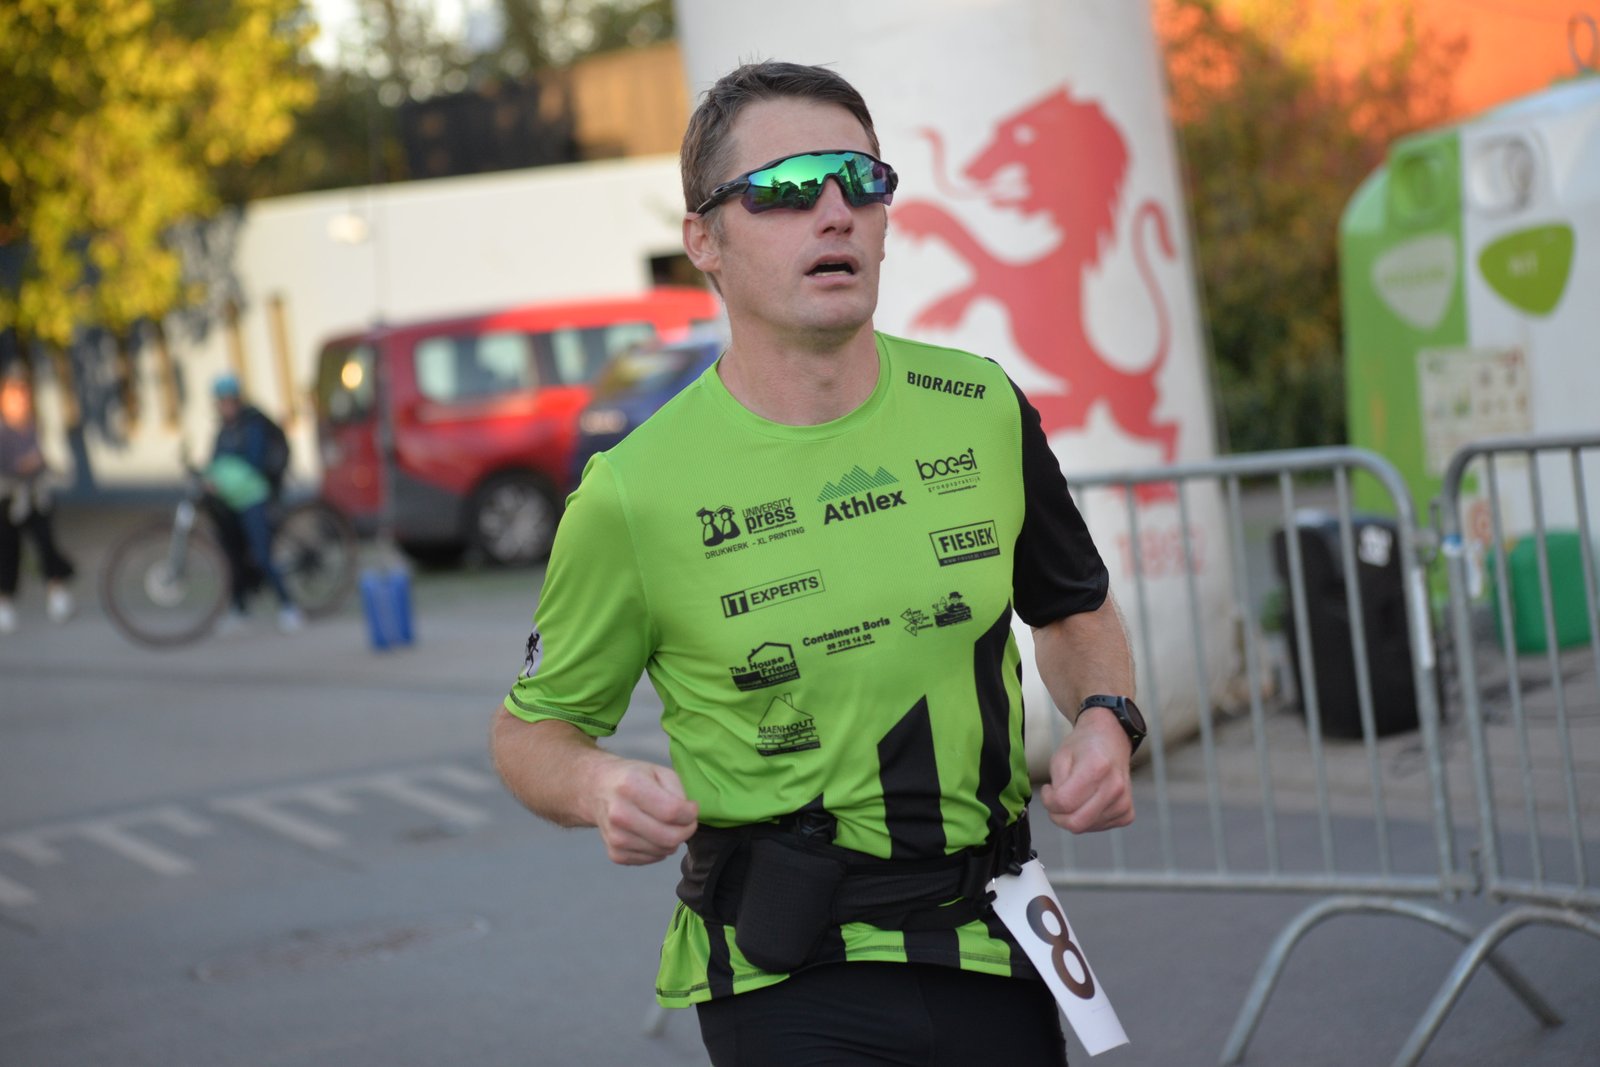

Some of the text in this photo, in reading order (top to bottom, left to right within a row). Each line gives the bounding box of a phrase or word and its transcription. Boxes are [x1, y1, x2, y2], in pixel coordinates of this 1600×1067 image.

[907, 371, 986, 399] BIORACER
[742, 497, 791, 518] UNIVERSITY
[745, 506, 796, 534] press
[824, 490, 907, 525] Athlex
[705, 541, 749, 559] DRUKWERK
[757, 537, 767, 545] XL
[768, 526, 805, 542] PRINTING
[938, 527, 994, 553] FIESIEK
[722, 576, 819, 617] IT EXPERTS
[803, 625, 860, 647] Containers
[862, 617, 890, 631] Boris
[729, 656, 785, 675] The House
[762, 661, 797, 677] Friend
[758, 718, 814, 735] MAENHOUT
[1026, 895, 1095, 1000] 8
